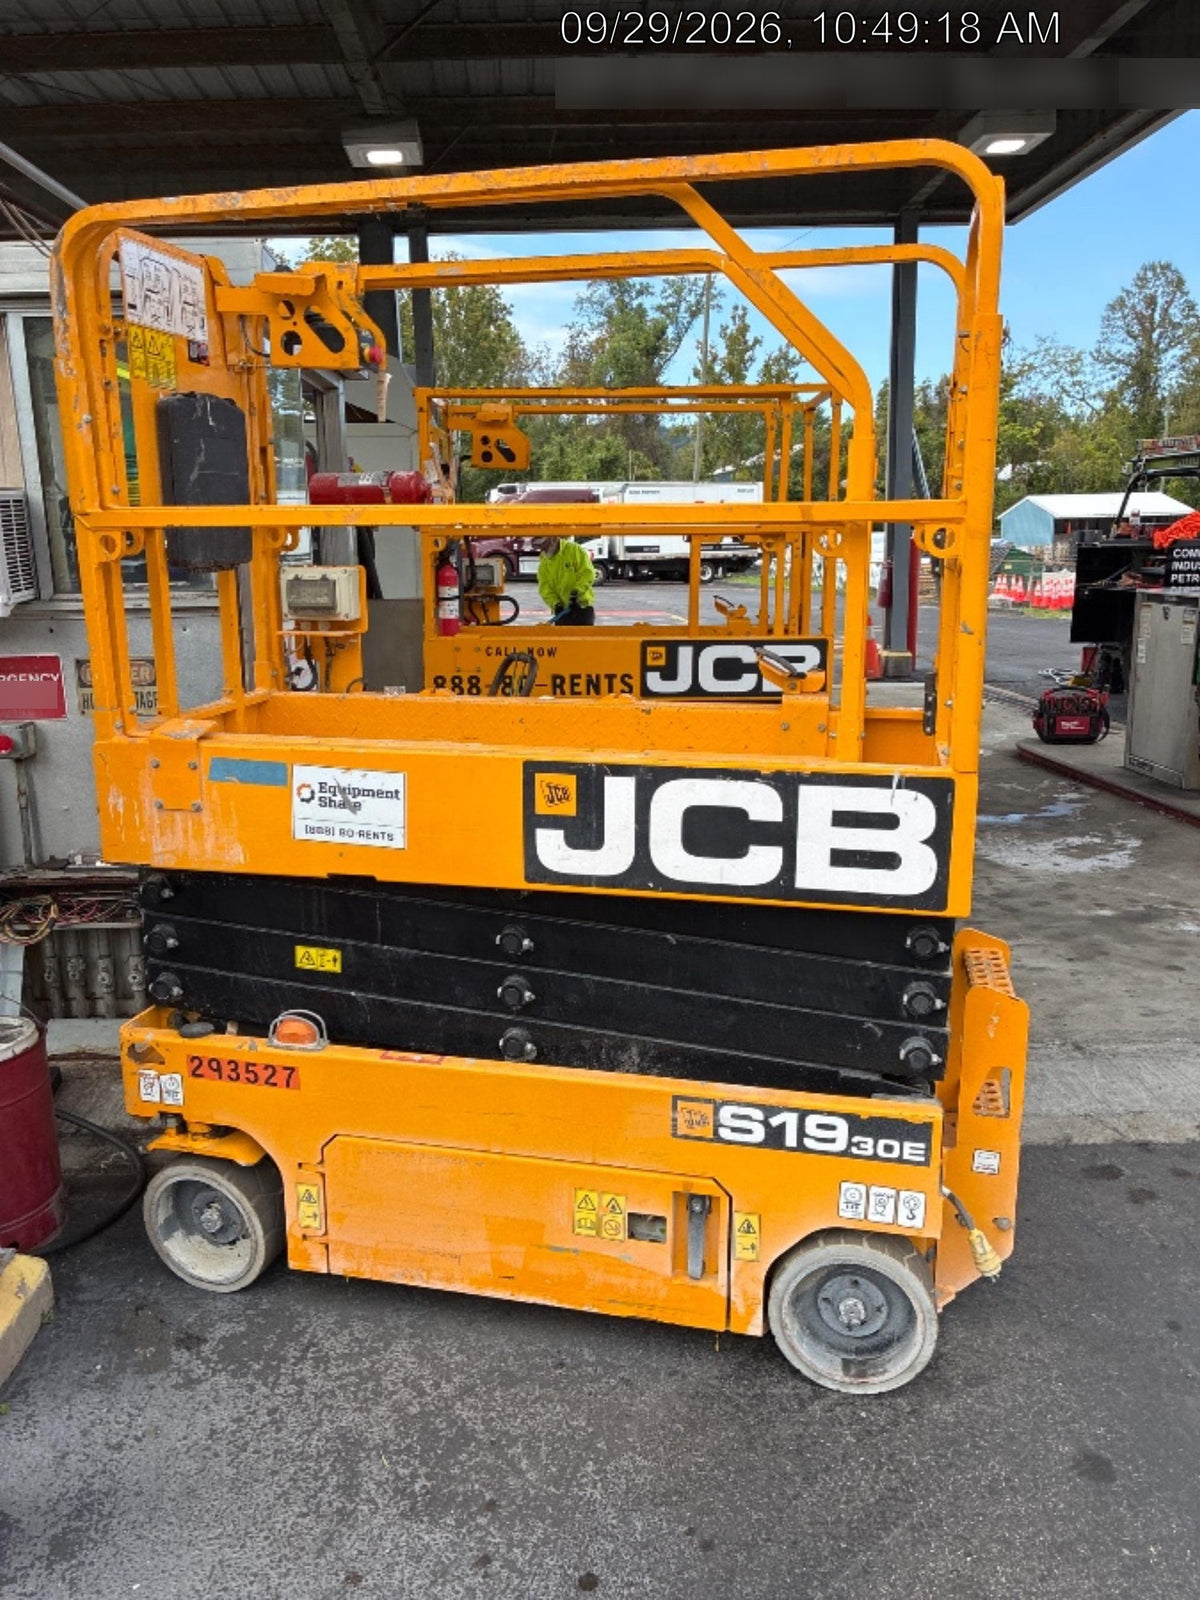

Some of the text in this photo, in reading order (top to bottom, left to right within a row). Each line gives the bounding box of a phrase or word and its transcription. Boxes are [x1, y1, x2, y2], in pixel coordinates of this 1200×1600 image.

[646, 645, 820, 693] JCB
[318, 796, 362, 811] Shae
[535, 776, 938, 897] JCB
[190, 1055, 297, 1088] 293527
